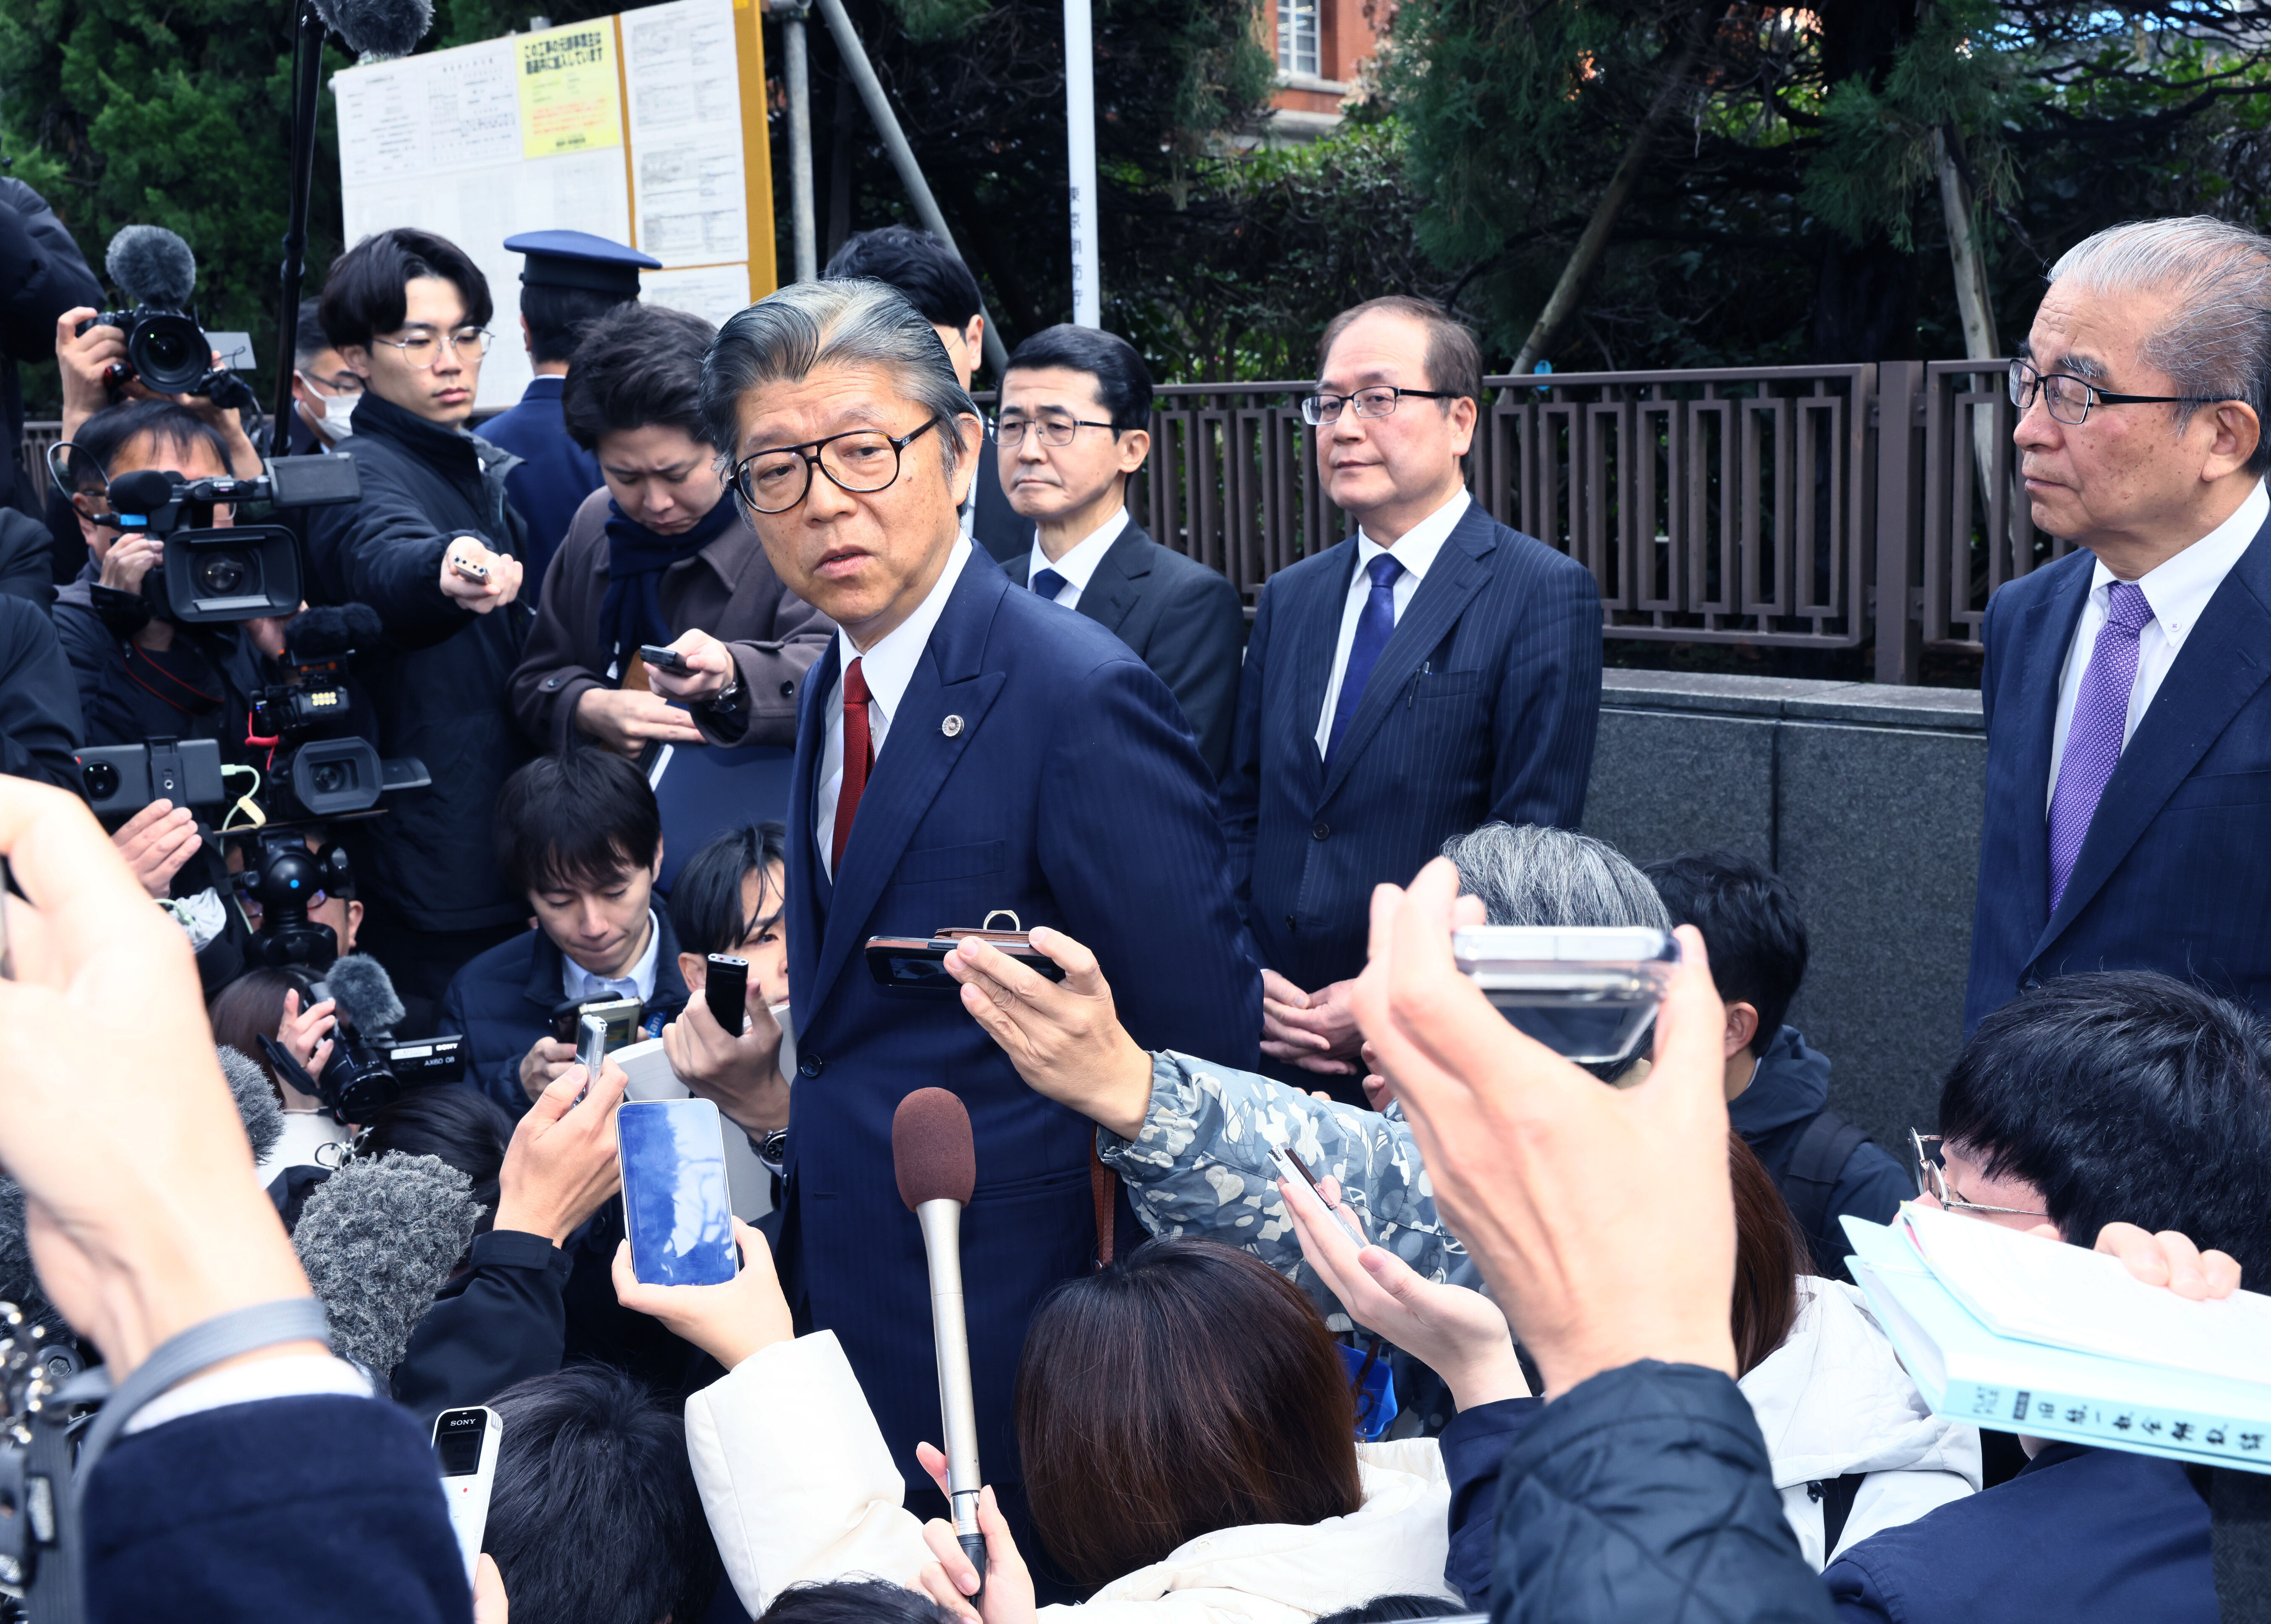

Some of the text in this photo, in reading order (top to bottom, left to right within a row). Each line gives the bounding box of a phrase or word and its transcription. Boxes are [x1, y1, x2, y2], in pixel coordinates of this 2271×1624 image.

[436, 1043, 458, 1051] SONY
[1973, 1386, 1986, 1414] FLAT
[1985, 1389, 2000, 1414] FILE
[450, 1418, 476, 1426] SONY
